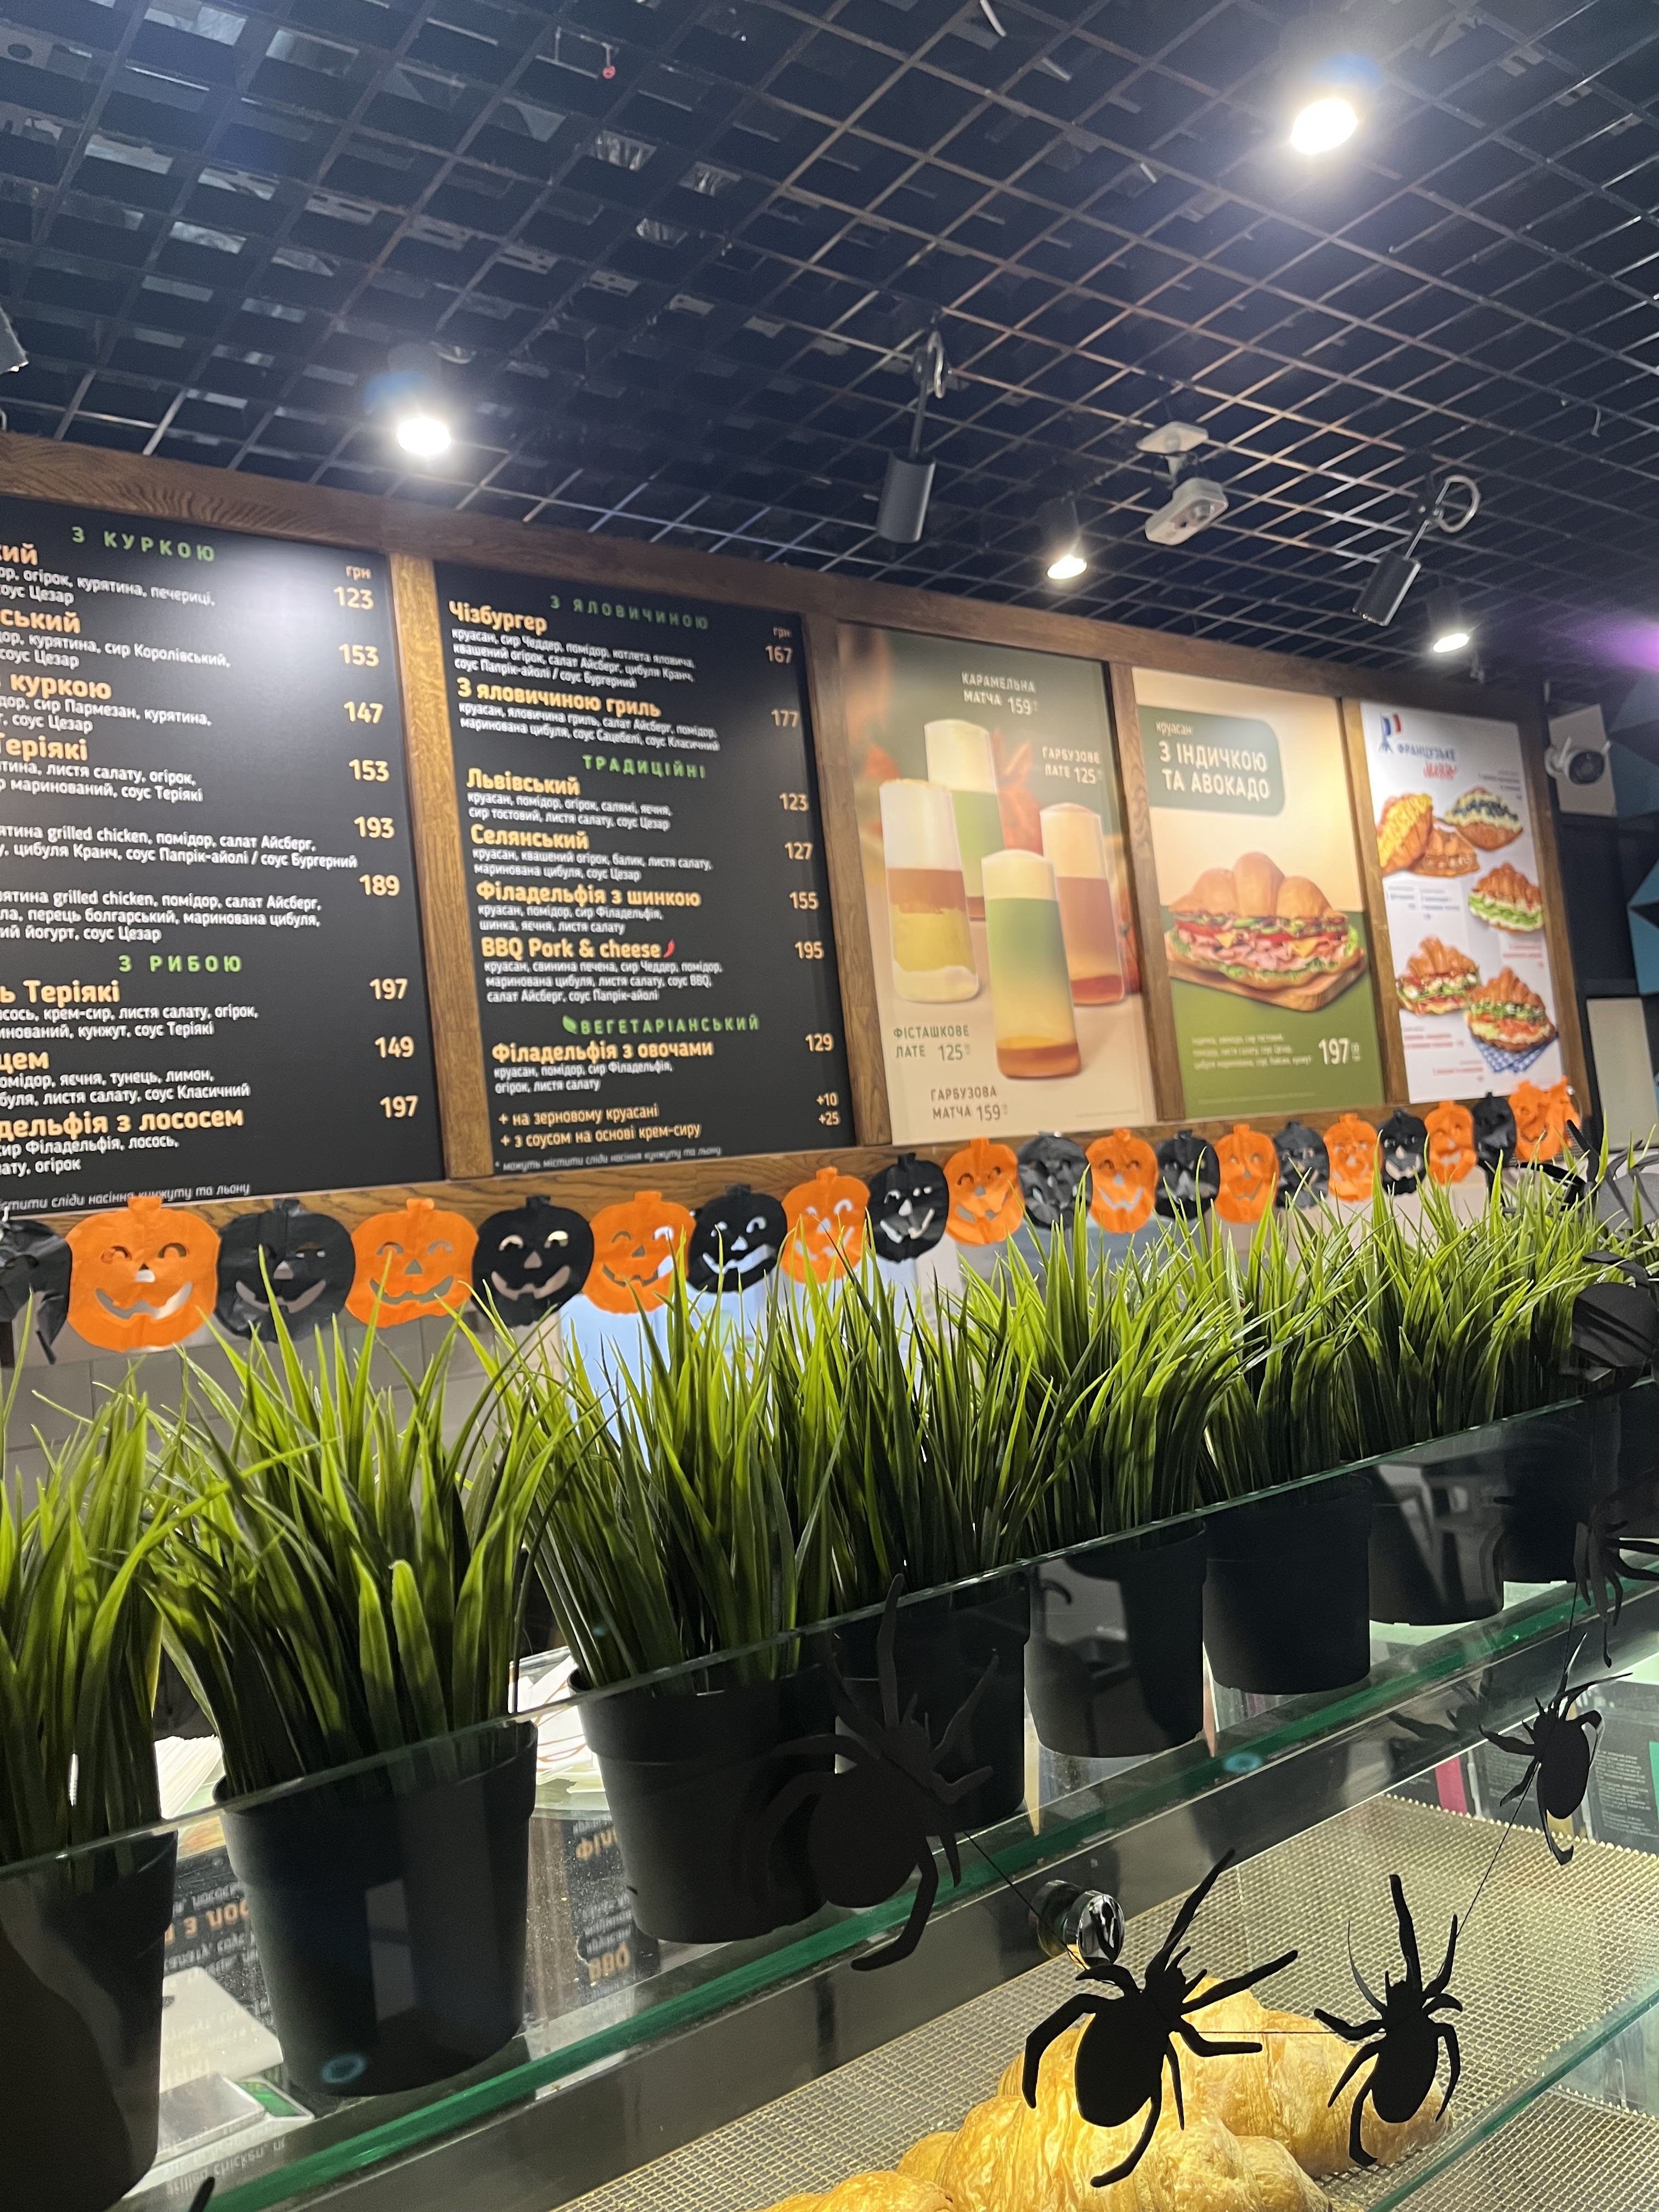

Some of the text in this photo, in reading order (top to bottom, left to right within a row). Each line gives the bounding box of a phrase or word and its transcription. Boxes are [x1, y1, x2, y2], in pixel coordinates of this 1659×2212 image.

[71, 526, 214, 561] З КУРКОЮ
[345, 565, 372, 581] грн
[28, 585, 75, 606] Цезар
[334, 586, 374, 610] 123
[448, 601, 548, 636] Чізбургер
[550, 594, 708, 629] З ЯЛОВИЧИНОЮ
[772, 627, 791, 639] грн
[33, 649, 80, 670] Цезар
[104, 642, 132, 659] сир
[338, 644, 380, 668] 153
[765, 645, 793, 664] 167
[9, 674, 112, 700] куркою
[961, 672, 1036, 693] КАРАМЕЛЬНА
[456, 676, 472, 698] З
[476, 684, 602, 711] яловичиною
[963, 689, 1002, 706] МАТЧА
[33, 698, 62, 715] сир
[343, 701, 384, 724] 147
[1007, 696, 1032, 716] 159
[12, 714, 94, 735] соус Цезар
[771, 709, 800, 728] 177
[1155, 721, 1193, 737] круасан
[1041, 746, 1101, 765] ГАРБУЗОВЕ
[1158, 740, 1268, 772] З ІНДИЧКОЮ
[46, 764, 91, 778] листя
[348, 759, 390, 782] 153
[582, 754, 705, 778] ТРАДИЦІЙНІ
[1044, 763, 1071, 778] ЛАТЕ
[1073, 766, 1097, 785] 125
[466, 768, 581, 795] Львівський
[1161, 768, 1271, 801] ТА АВОКАДО
[120, 786, 152, 802] соус
[154, 785, 204, 803] Теріякі
[779, 792, 809, 812] 123
[47, 825, 93, 843] grilled
[219, 836, 258, 849] салат
[353, 816, 395, 839] 193
[470, 823, 590, 849] Селянський
[13, 841, 70, 860] цибуля
[125, 848, 156, 864] соус
[159, 847, 250, 865] Папрік-айолі
[260, 853, 289, 869] соус
[290, 851, 358, 870] Бургерний
[784, 841, 814, 860] 127
[359, 874, 400, 896] 189
[476, 881, 607, 907] Філадельфія
[610, 889, 623, 905] з
[52, 889, 99, 908] grilled
[224, 896, 263, 909] салат
[789, 891, 819, 910] 155
[27, 909, 82, 924] перець
[182, 912, 267, 927] маринована
[82, 927, 115, 943] соус
[117, 925, 162, 944] Цезар
[481, 936, 524, 962] BBQ
[794, 940, 825, 960] 195
[118, 954, 242, 973] З РИБОЮ
[22, 979, 120, 1008] Теріякі
[369, 978, 408, 1000] 197
[118, 1007, 160, 1020] листя
[134, 1024, 165, 1040] соус
[166, 1020, 215, 1039] Теріякі
[893, 1024, 970, 1040] ФІСТАШКОВЕ
[374, 1035, 415, 1058] 149
[805, 1032, 834, 1052] 129
[895, 1044, 926, 1059] ЛАТЕ
[1318, 1037, 1350, 1065] 197
[491, 1040, 618, 1065] Філадельфія
[622, 1043, 634, 1059] з
[938, 1043, 964, 1062] 125
[42, 1091, 87, 1105] листя
[144, 1087, 174, 1104] соус
[176, 1082, 251, 1099] Класичний
[816, 1092, 839, 1107] +10
[930, 1085, 997, 1102] ГАРБУЗОВА
[380, 1095, 419, 1119] 197
[932, 1105, 972, 1120] МАТЧА
[975, 1103, 1001, 1122] 159
[116, 1109, 244, 1133] з лососем
[512, 1112, 531, 1126] на
[818, 1110, 840, 1126] +25
[514, 1135, 523, 1149] з
[574, 1130, 593, 1144] на
[34, 1157, 82, 1175] огірок
[196, 1183, 250, 1197] та льону
